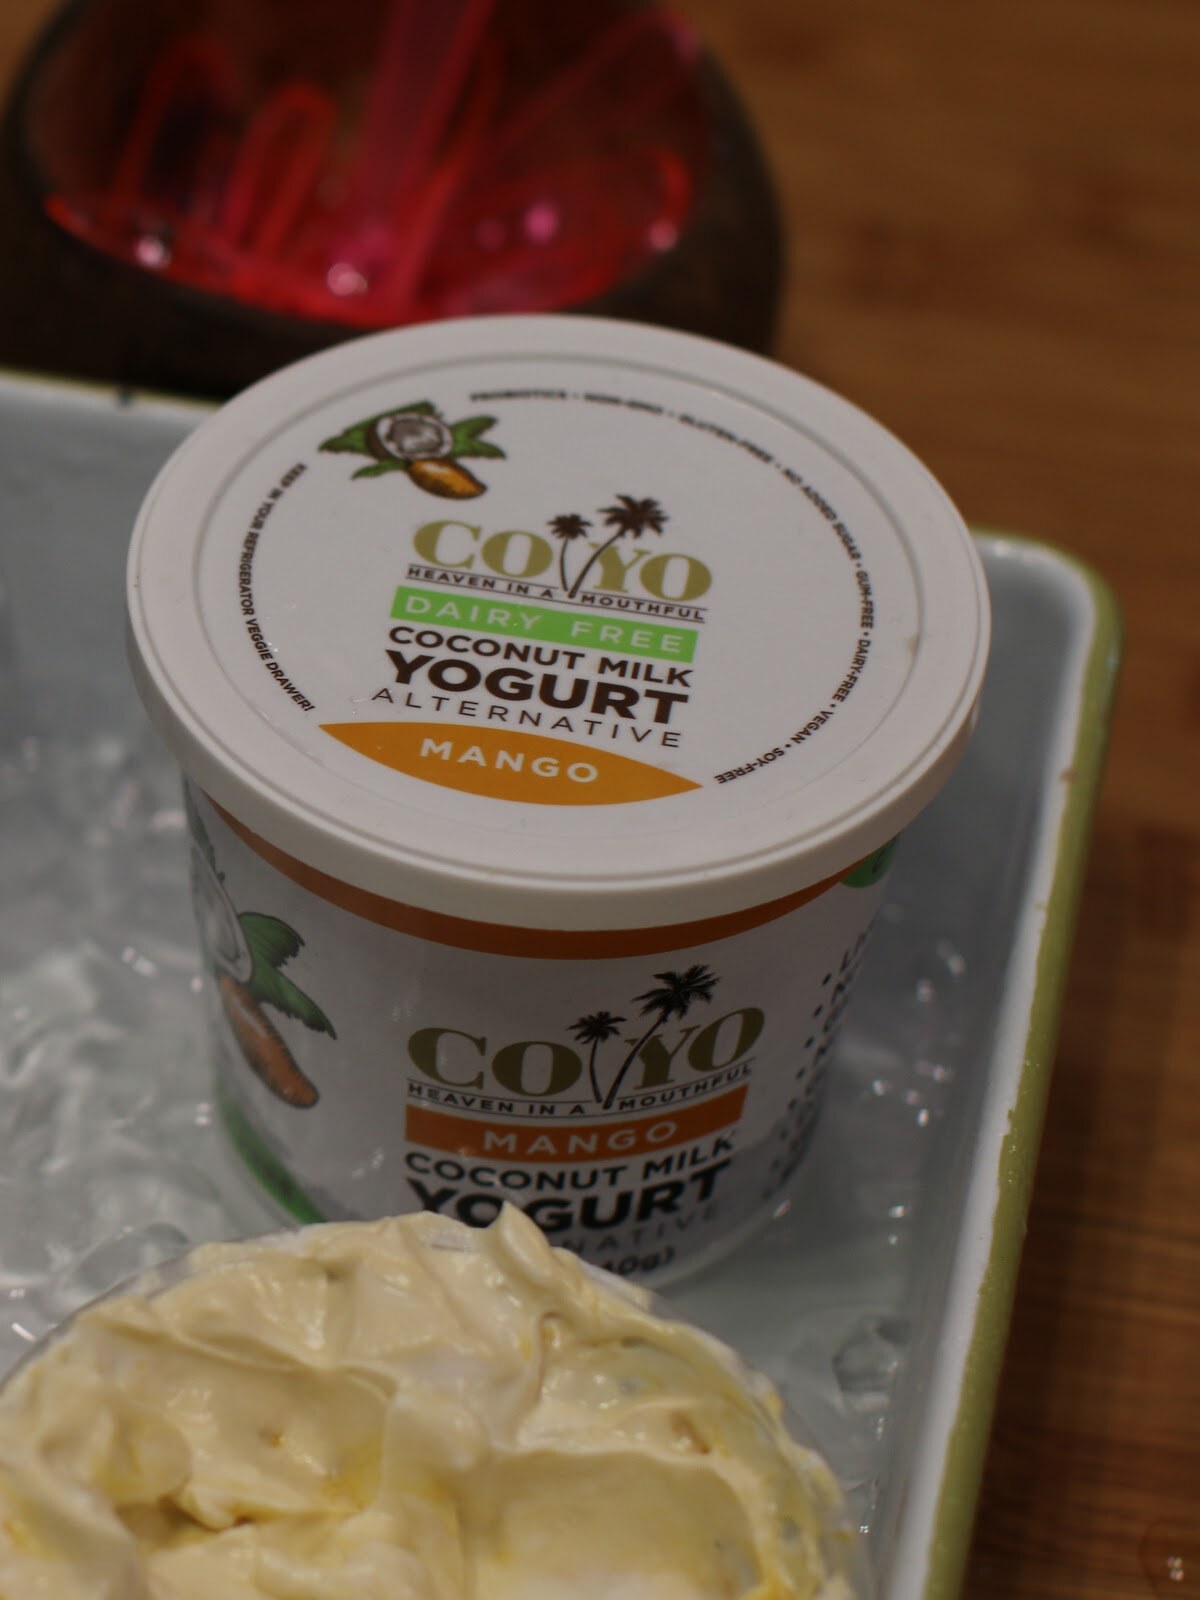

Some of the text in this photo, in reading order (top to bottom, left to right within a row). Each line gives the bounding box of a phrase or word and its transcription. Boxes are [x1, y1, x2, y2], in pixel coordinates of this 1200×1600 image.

[250, 501, 275, 531] YOUR
[238, 531, 259, 616] REFRIGERATOR
[407, 566, 706, 622] HEAVEN IN A MOUTHFUL
[856, 571, 874, 629] GUM-FREE
[245, 618, 273, 661] VEGGIE
[404, 595, 685, 654] DAIRY FREE
[388, 626, 695, 688] COCONUT MILK
[831, 639, 871, 703] DAIRY-FREE
[265, 662, 316, 712] DRAWER!
[385, 649, 689, 725] YOGURT
[371, 687, 682, 748] ALTERNATIVE
[790, 710, 834, 744] VEGAN
[420, 738, 599, 784] MANGO
[713, 747, 785, 785] SOY-FREE
[407, 1063, 753, 1116] HEAVEN IN A MOUTHFUL
[404, 1129, 738, 1192] COCONUT MILK
[481, 1120, 678, 1158] MANGO
[404, 1158, 733, 1234] YOGURT
